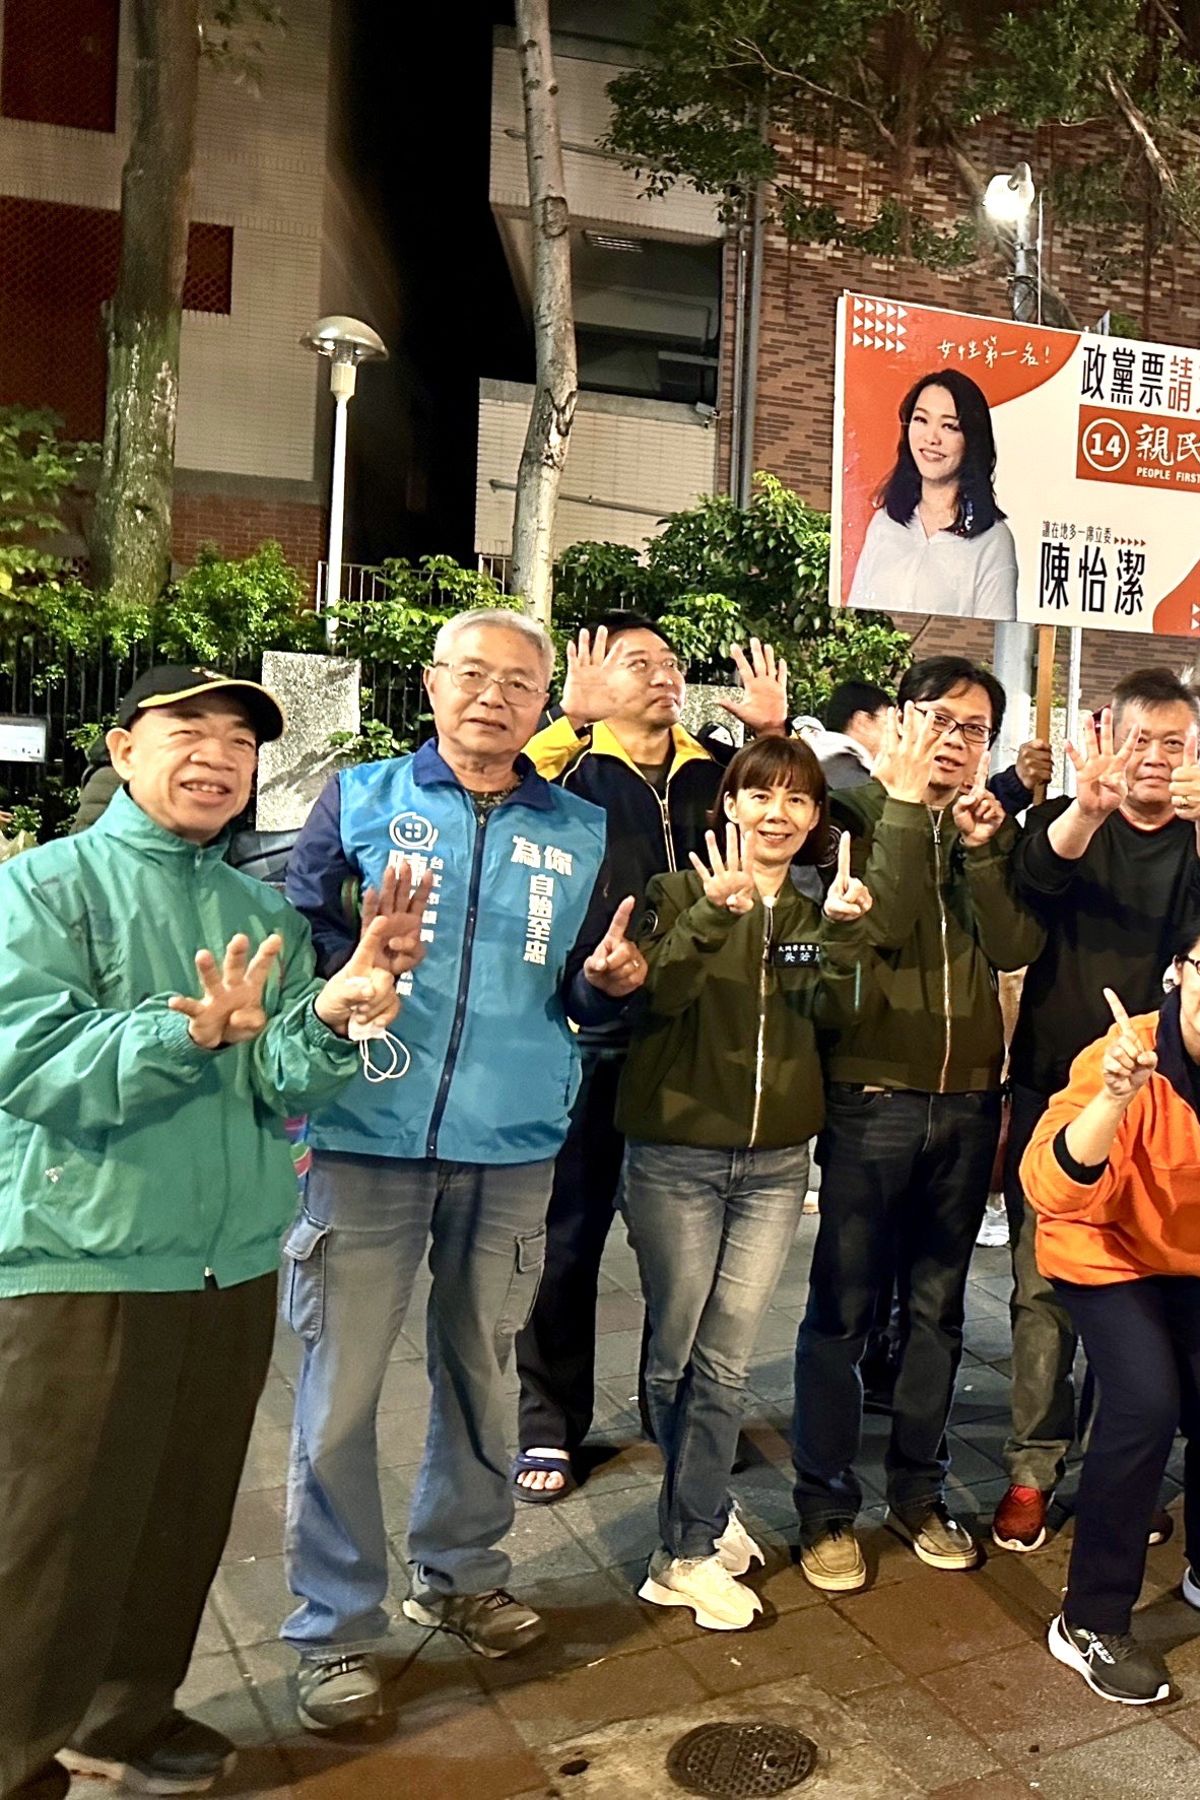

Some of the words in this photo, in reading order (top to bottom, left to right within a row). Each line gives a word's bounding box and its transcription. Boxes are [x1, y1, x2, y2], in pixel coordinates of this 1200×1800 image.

[1090, 432, 1122, 458] 14
[1136, 466, 1171, 481] PEOPLE
[1039, 541, 1146, 616] 陳怡潔
[511, 834, 573, 877] 為你
